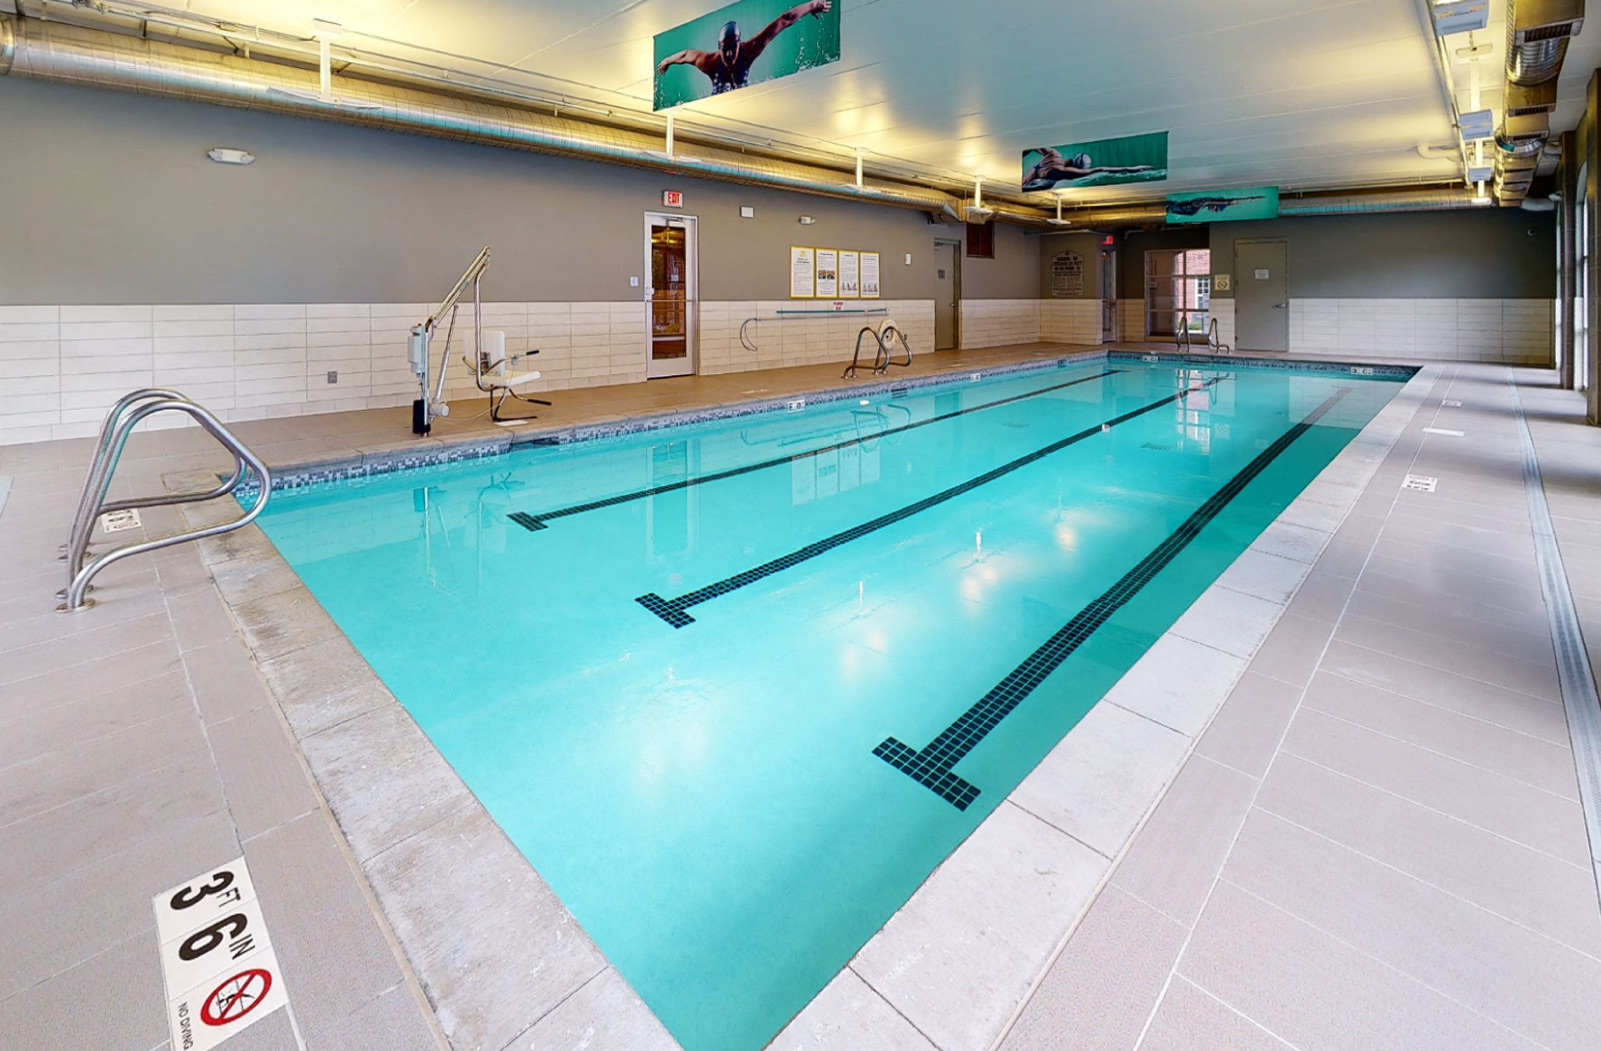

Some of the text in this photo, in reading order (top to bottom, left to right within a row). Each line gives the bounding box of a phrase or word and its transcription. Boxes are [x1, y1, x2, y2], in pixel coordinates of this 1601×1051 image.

[667, 192, 681, 205] EXIT
[170, 870, 256, 961] 3 FT 6 IN
[178, 1001, 194, 1050] NO DIVING
